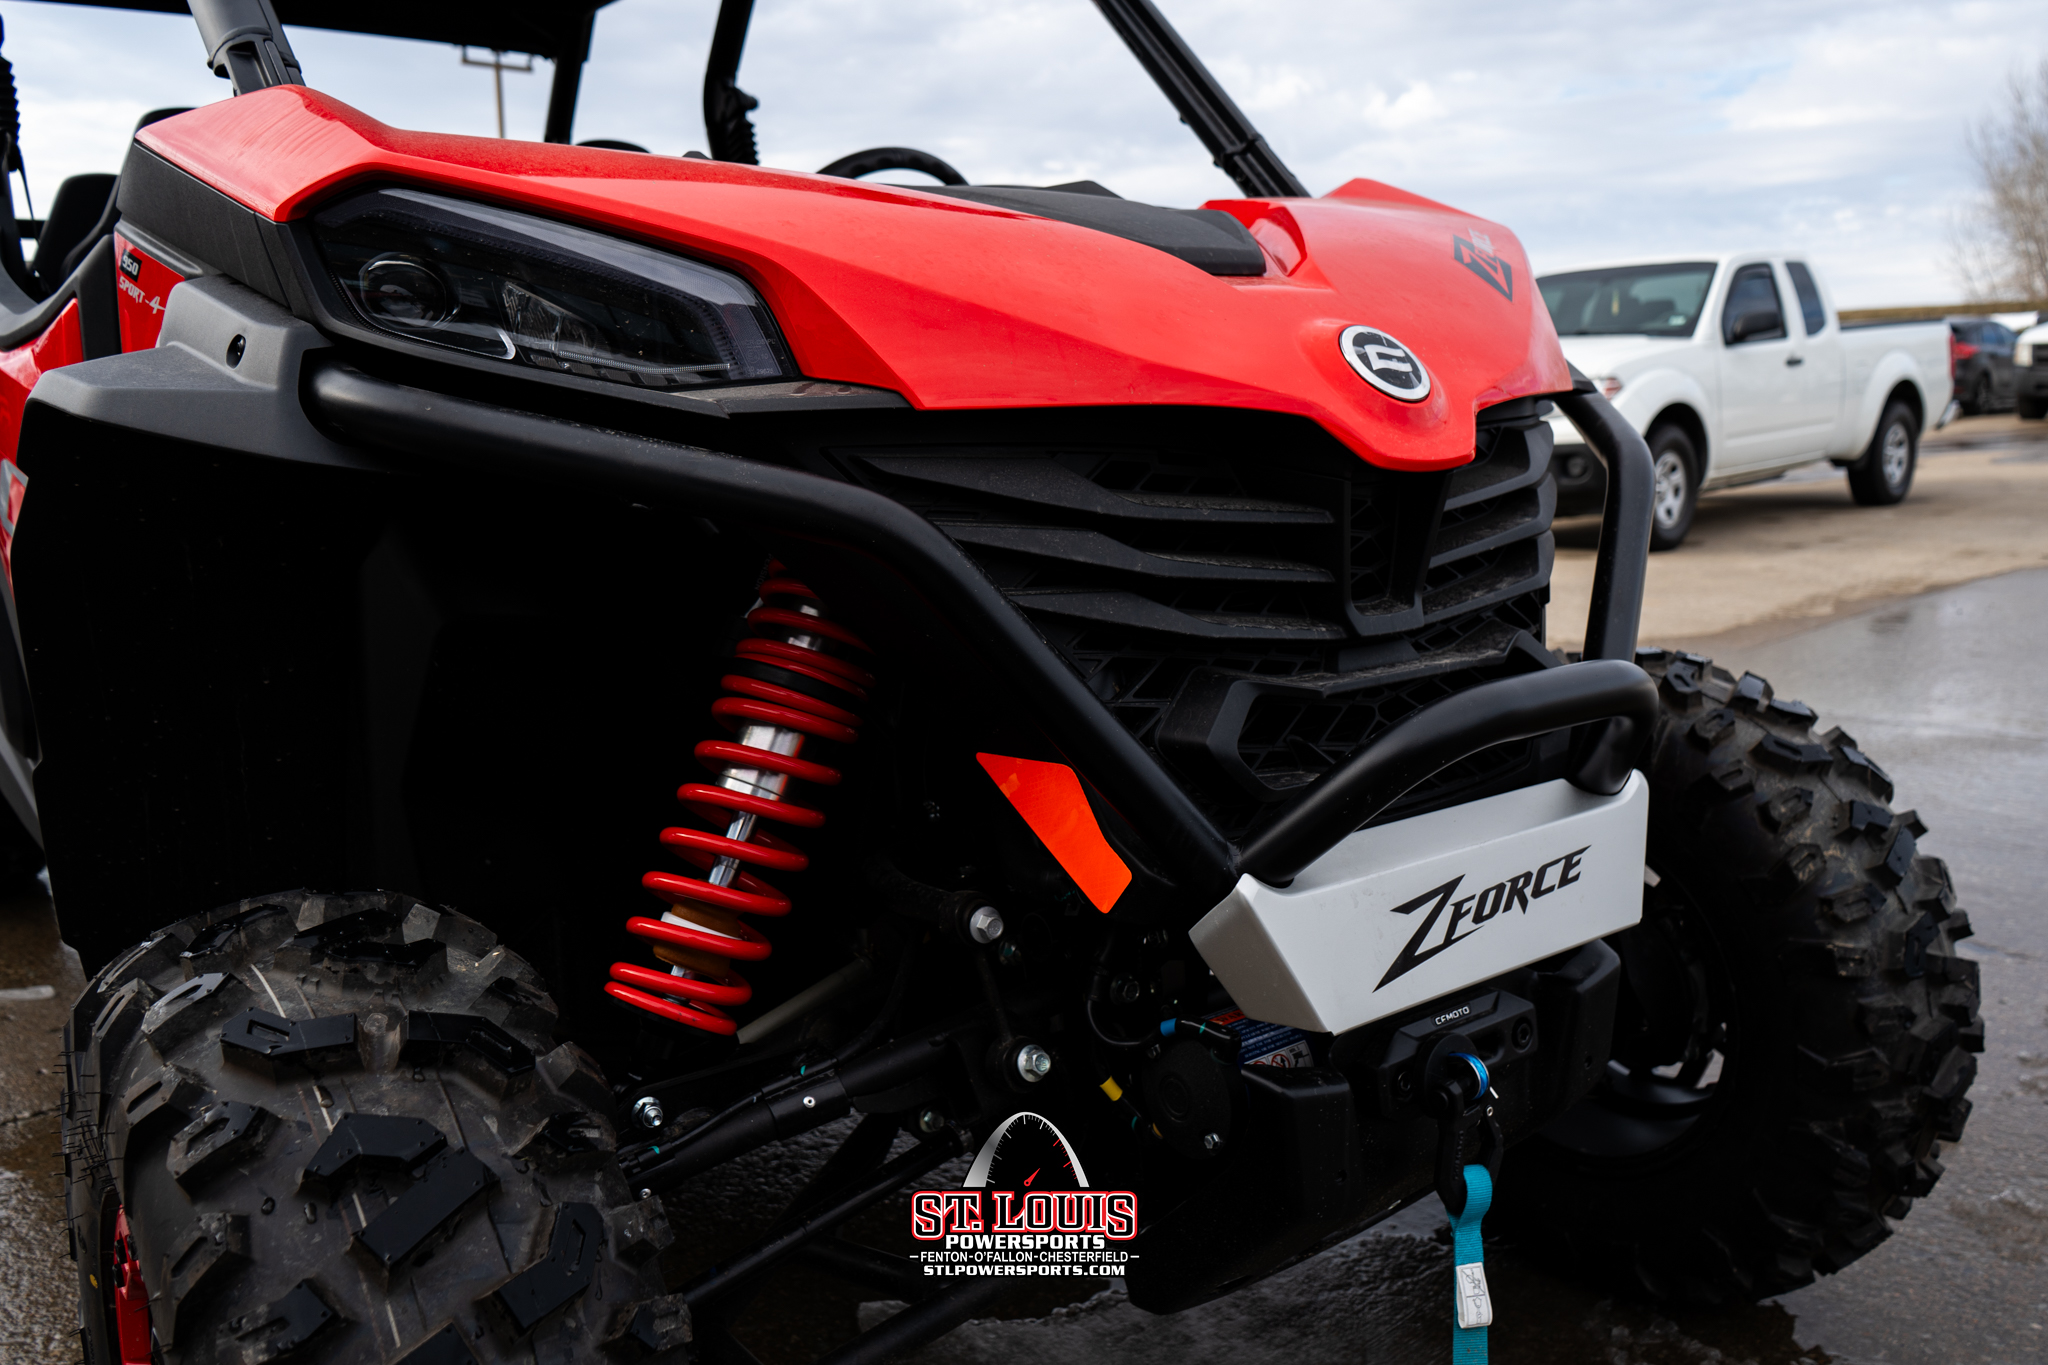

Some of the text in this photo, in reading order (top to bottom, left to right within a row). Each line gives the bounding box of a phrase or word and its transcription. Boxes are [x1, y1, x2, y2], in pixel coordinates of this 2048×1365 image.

[122, 254, 140, 276] 950
[1372, 845, 1592, 993] ZFORCE
[1435, 1006, 1470, 1025] CFMOTO
